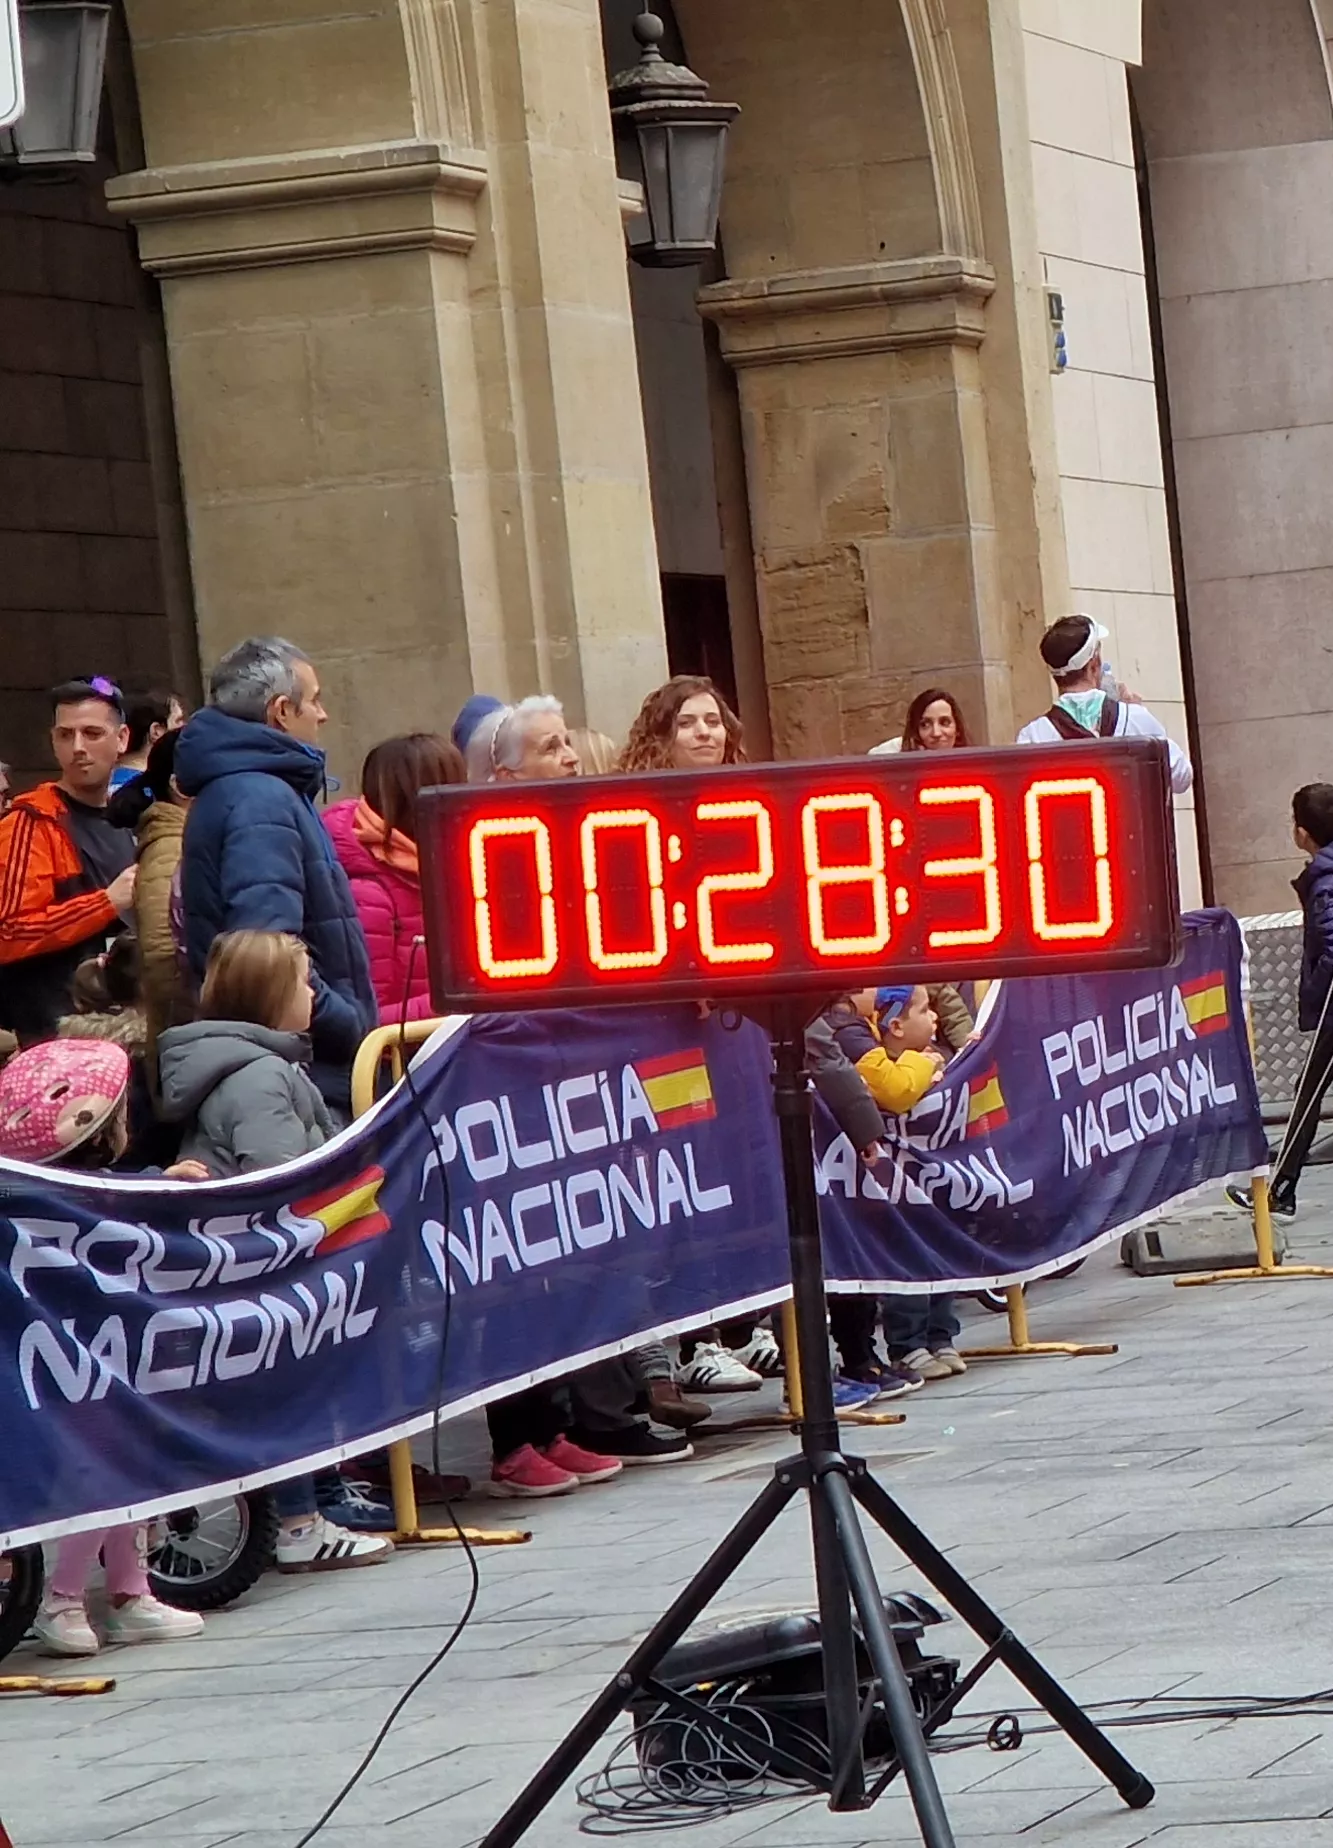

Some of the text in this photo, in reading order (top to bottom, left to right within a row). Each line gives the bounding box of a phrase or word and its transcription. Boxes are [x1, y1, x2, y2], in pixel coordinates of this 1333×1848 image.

[469, 778, 1113, 979] 00:28:30
[1041, 984, 1197, 1100] POLICÍA
[419, 1063, 661, 1202] POLICÍA
[1060, 1048, 1238, 1178] NACIONAL
[8, 1204, 327, 1300] POLICÍA
[420, 1140, 734, 1295] NACIONAL
[18, 1260, 381, 1411] NACIONAL
